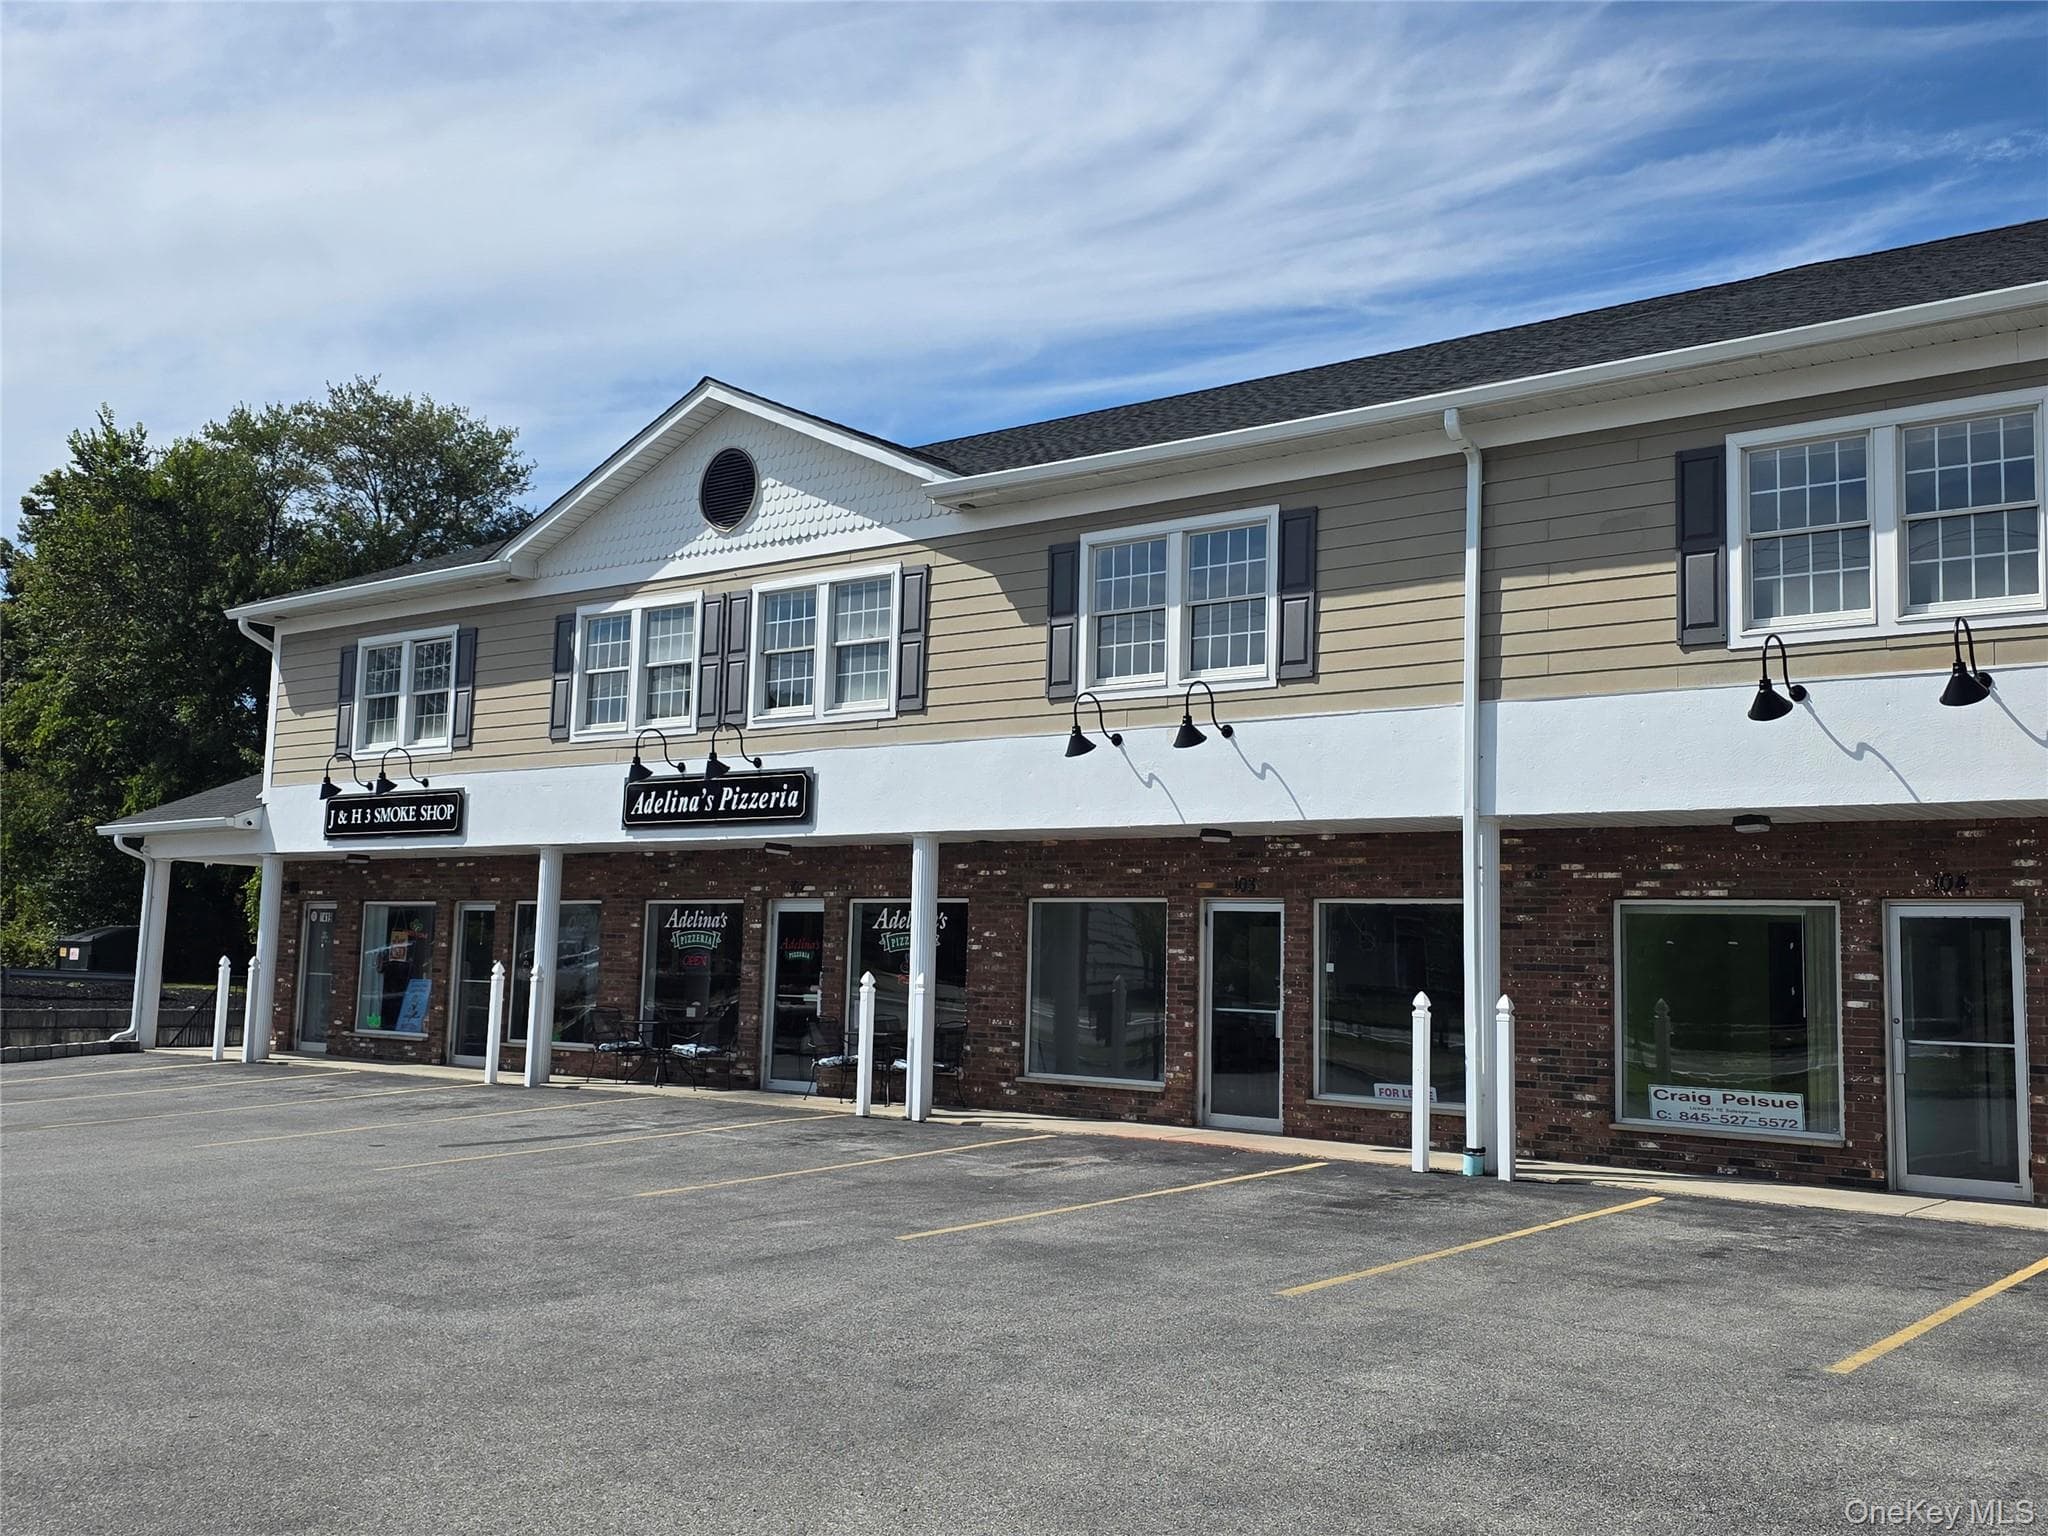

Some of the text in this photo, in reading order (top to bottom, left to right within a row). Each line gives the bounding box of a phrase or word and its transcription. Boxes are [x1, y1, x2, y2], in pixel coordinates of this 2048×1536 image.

[631, 783, 799, 815] Adelina's Pizzeria
[328, 804, 455, 829] J & H 3 SMOKE SHOP
[664, 908, 728, 928] Adelina's
[872, 907, 948, 930] Adel's
[680, 934, 712, 945] PIZZERIA
[1378, 1088, 1400, 1098] FOR
[1653, 1089, 1799, 1109] Craig Pelsue
[1656, 1110, 1799, 1129] C: 845-527-5572
